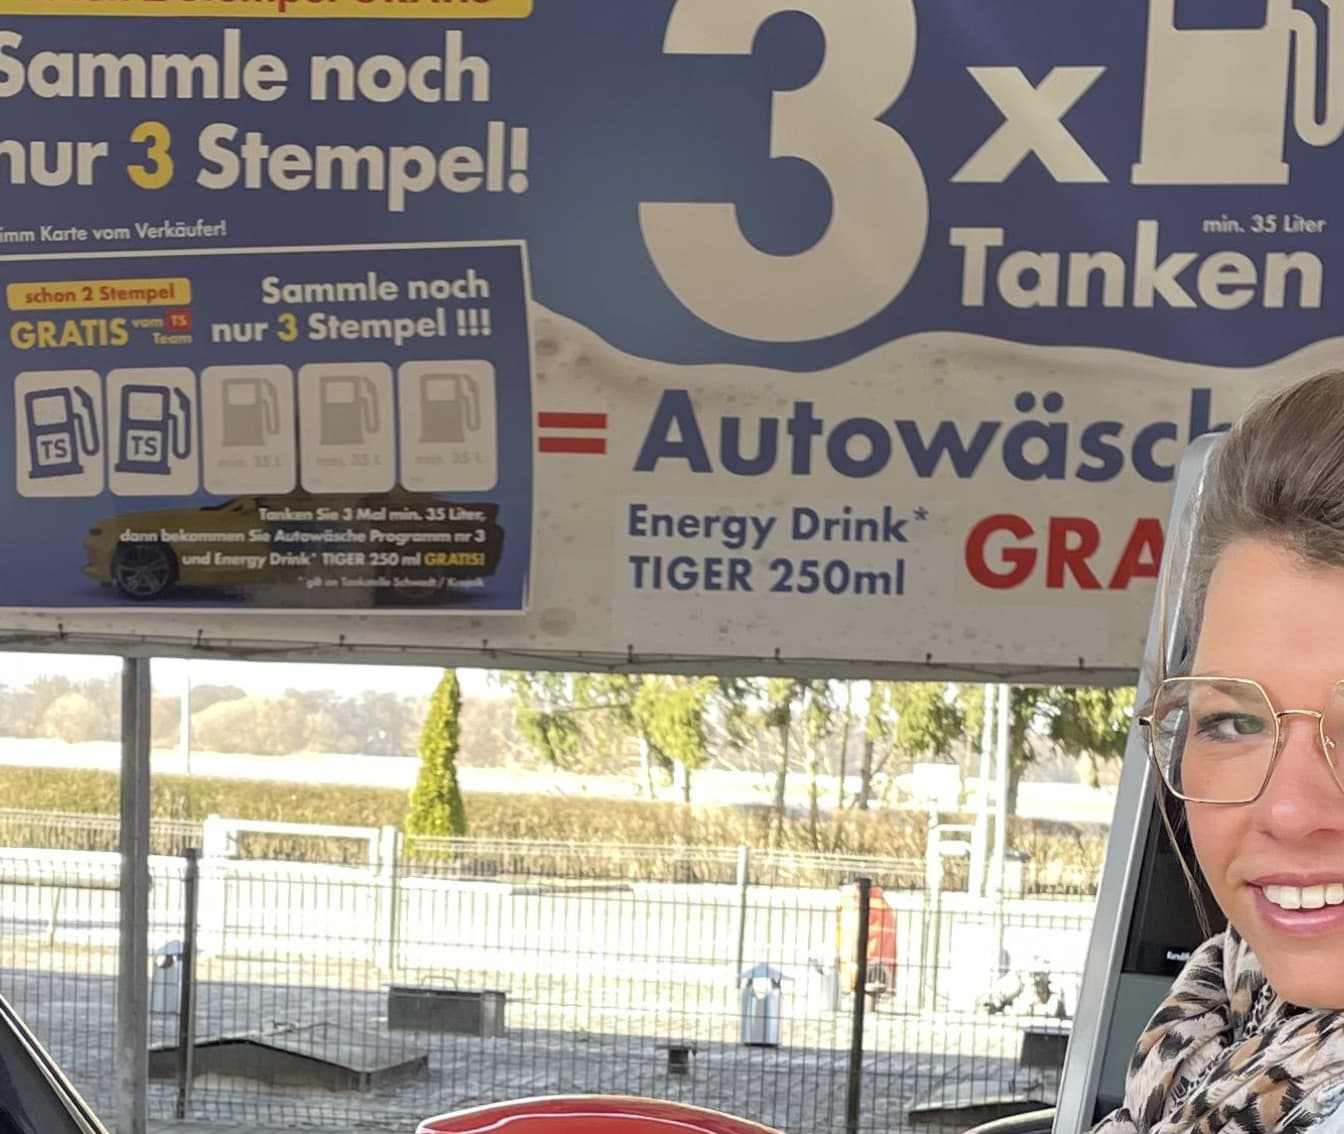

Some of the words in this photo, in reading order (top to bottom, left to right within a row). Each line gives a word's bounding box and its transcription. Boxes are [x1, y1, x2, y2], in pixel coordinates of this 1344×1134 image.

[310, 29, 490, 102] noch
[127, 121, 174, 190] 3
[196, 121, 530, 212] Stempel!
[639, 0, 929, 343] 3
[950, 66, 1110, 184] x
[40, 225, 87, 242] Karte
[92, 227, 130, 240] vom
[135, 218, 227, 239] Verkäufer!
[1202, 213, 1245, 233] min.
[1250, 213, 1277, 233] 35
[1283, 213, 1327, 233] Liter
[949, 220, 1324, 310] Tanken
[25, 286, 76, 304] schon
[82, 286, 94, 302] 2
[100, 282, 175, 304] Stempel
[261, 271, 399, 305] Sammle
[408, 268, 490, 300] noch
[10, 317, 130, 350] GRATIS
[170, 314, 188, 328] TS
[212, 322, 269, 343] nur
[277, 312, 299, 343] 3
[308, 306, 447, 347] Stempel
[40, 438, 68, 459] TS
[131, 436, 158, 456] TS
[259, 507, 312, 522] Tanken
[317, 507, 339, 521] Sie
[342, 507, 353, 521] 3
[357, 507, 387, 521] Mal
[425, 507, 445, 521] 35
[628, 503, 777, 550] Energy
[120, 529, 158, 542] dann
[161, 528, 244, 543] bekommen
[248, 529, 272, 542] Sie
[274, 529, 366, 543] Autowäsche
[370, 530, 452, 546] Programm
[475, 530, 486, 543] 3
[182, 552, 211, 566] und
[214, 552, 267, 569] Energy
[322, 552, 366, 566] TIGER
[369, 552, 399, 566] 250
[401, 552, 421, 566] ml
[424, 552, 485, 566] GRATIS!
[628, 555, 754, 592] TIGER
[769, 557, 905, 596] 250ml
